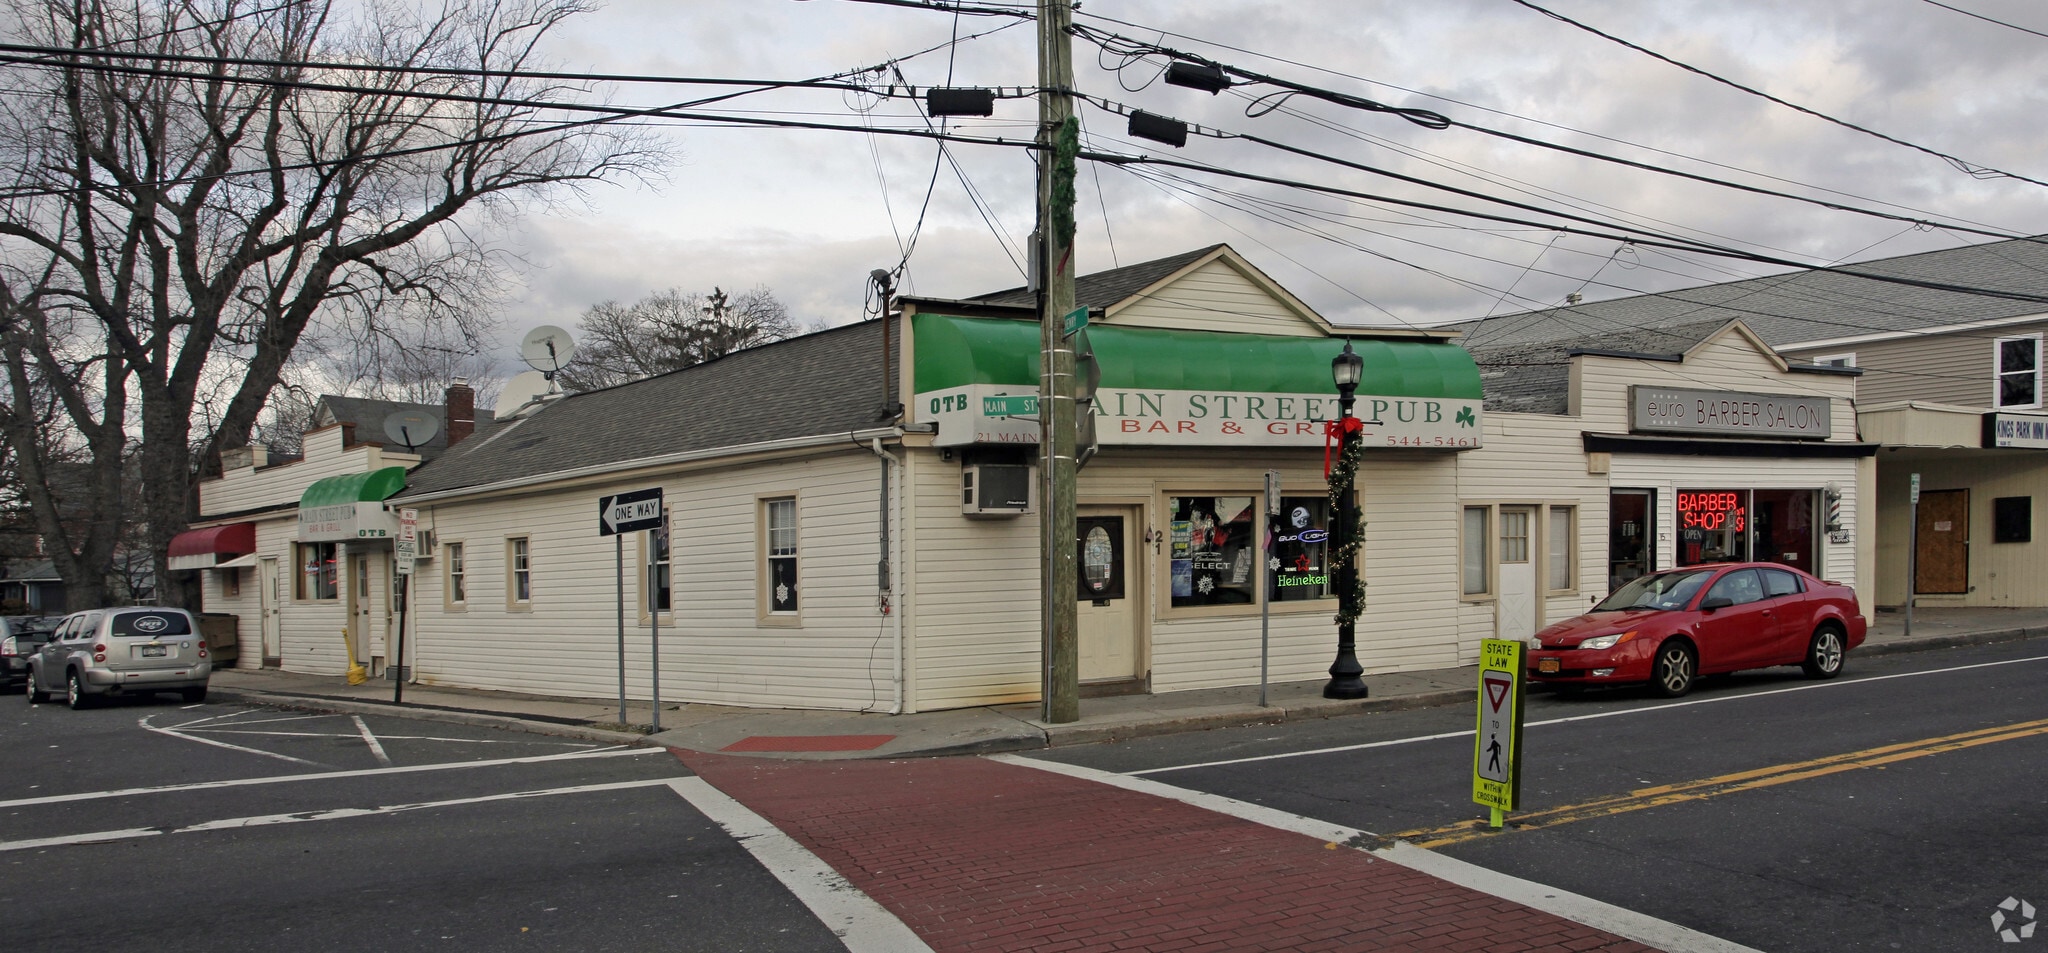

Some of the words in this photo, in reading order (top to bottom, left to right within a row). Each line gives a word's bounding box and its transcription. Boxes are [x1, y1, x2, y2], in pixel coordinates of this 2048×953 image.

[930, 394, 967, 414] OTB
[984, 400, 1007, 412] MAIN
[1024, 400, 1036, 412] ST
[1088, 392, 1165, 418] AIN
[1371, 399, 1442, 423] PUB
[1647, 401, 1685, 418] euro
[1697, 399, 1760, 426] BARBER
[1766, 403, 1821, 429] SALON
[1121, 420, 1198, 433] BAR
[1220, 421, 1245, 435] &
[1997, 420, 2014, 438] KINGS
[2016, 421, 2031, 439] PARK
[977, 433, 991, 443] 21
[998, 433, 1037, 443] MAIN
[1386, 436, 1478, 447] 544-5461
[1678, 493, 1737, 511] BARBER
[615, 506, 632, 520] ONE
[637, 502, 657, 517] WAY
[1683, 511, 1726, 530] SHOP
[359, 529, 386, 537] OTB
[1304, 532, 1329, 540] LIGHT
[1684, 529, 1702, 540] OPEN
[1277, 574, 1328, 586] Heineken
[1487, 643, 1512, 656] STATE
[1489, 657, 1508, 668] LAW
[1492, 720, 1499, 729] TO
[1483, 783, 1502, 794] WITHIN
[1476, 791, 1507, 806] CROSSWALK
